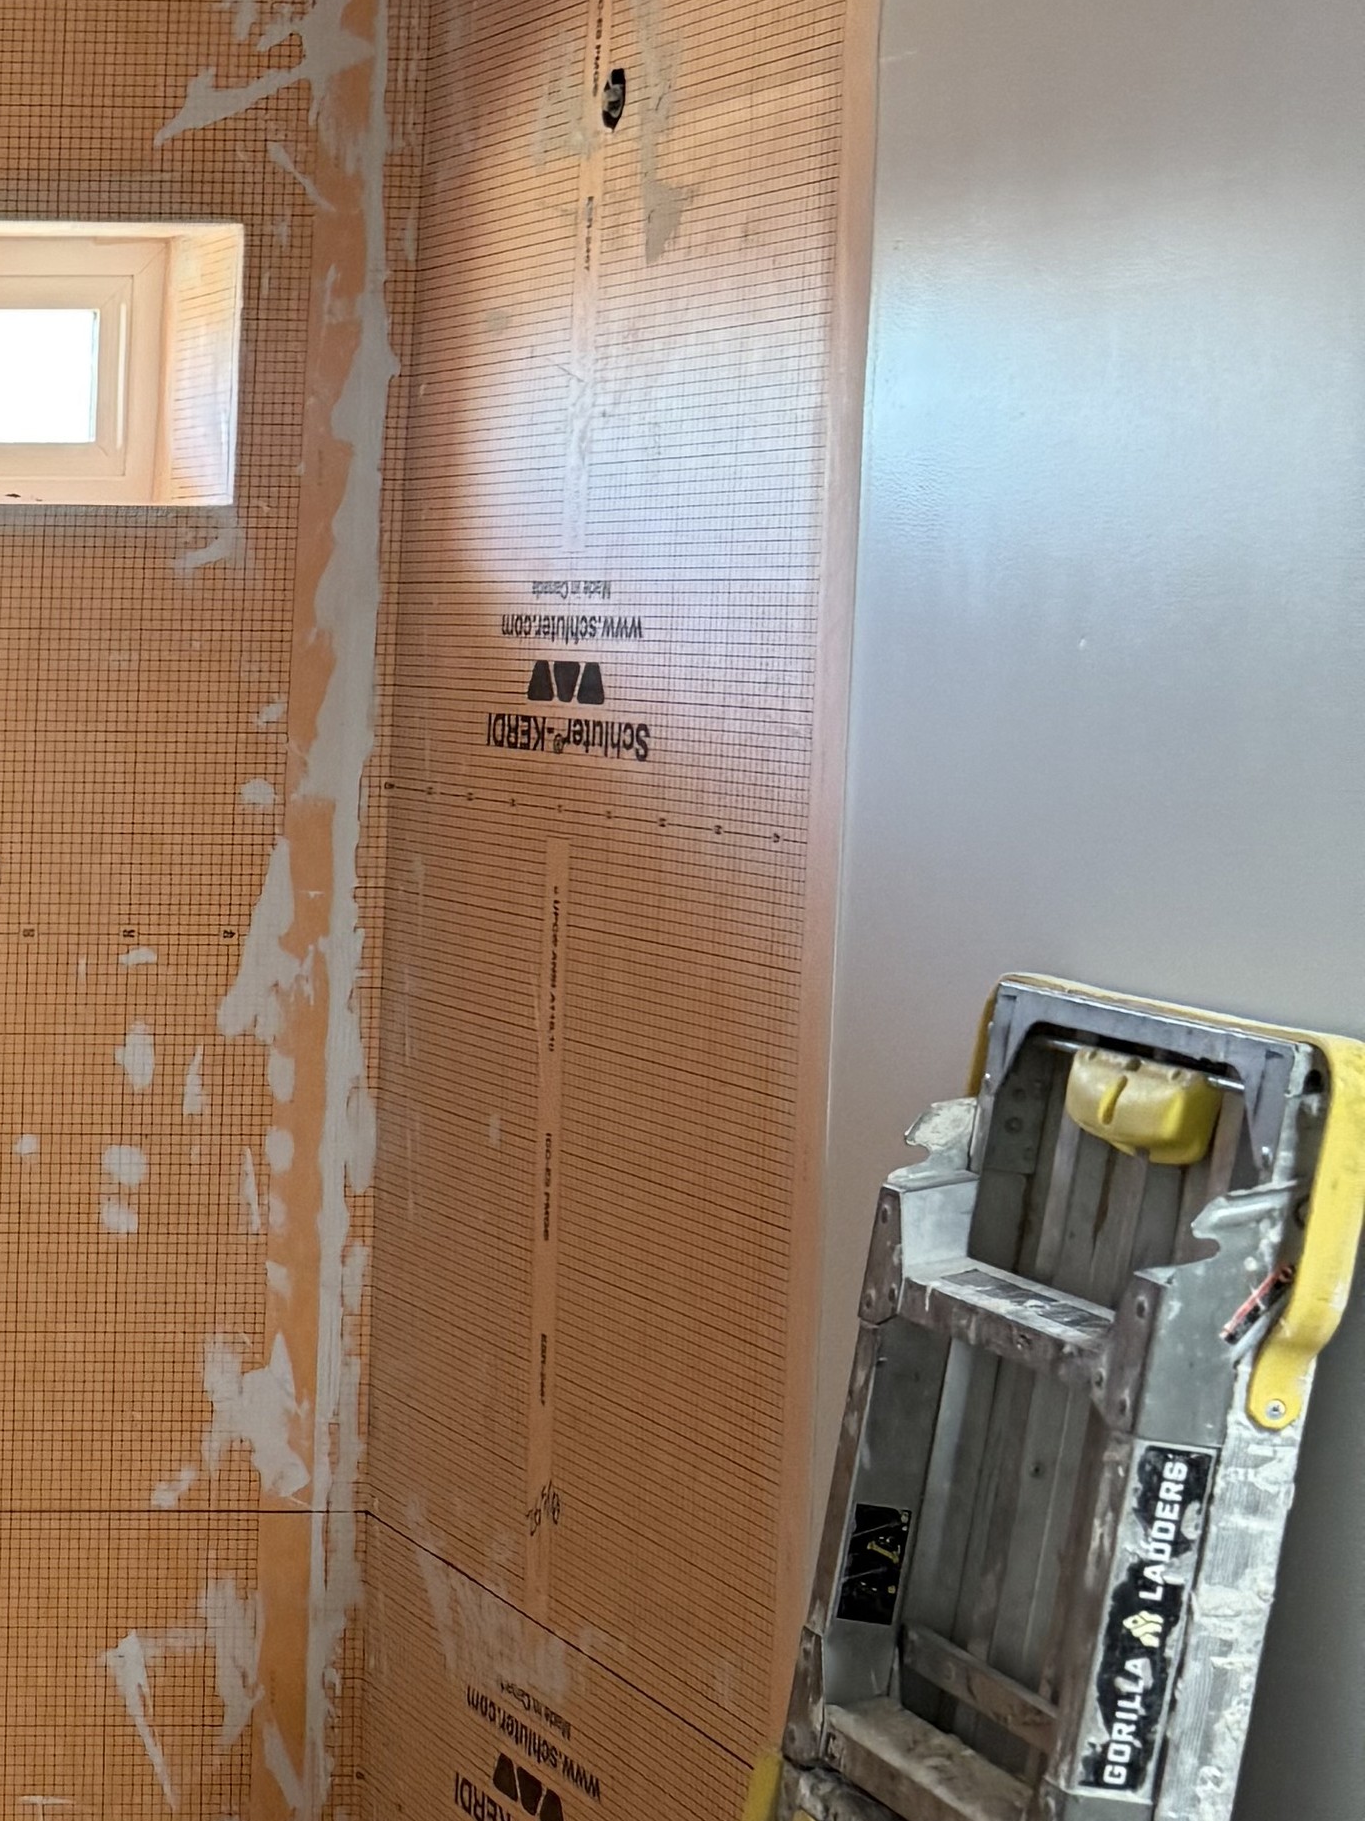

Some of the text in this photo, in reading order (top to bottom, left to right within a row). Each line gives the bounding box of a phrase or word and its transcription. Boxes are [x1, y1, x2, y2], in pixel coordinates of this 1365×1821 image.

[501, 615, 642, 644] www.schluter.com
[1103, 1462, 1189, 1785] GORILLA LADDERS
[467, 1685, 600, 1804] www.schluter.com
